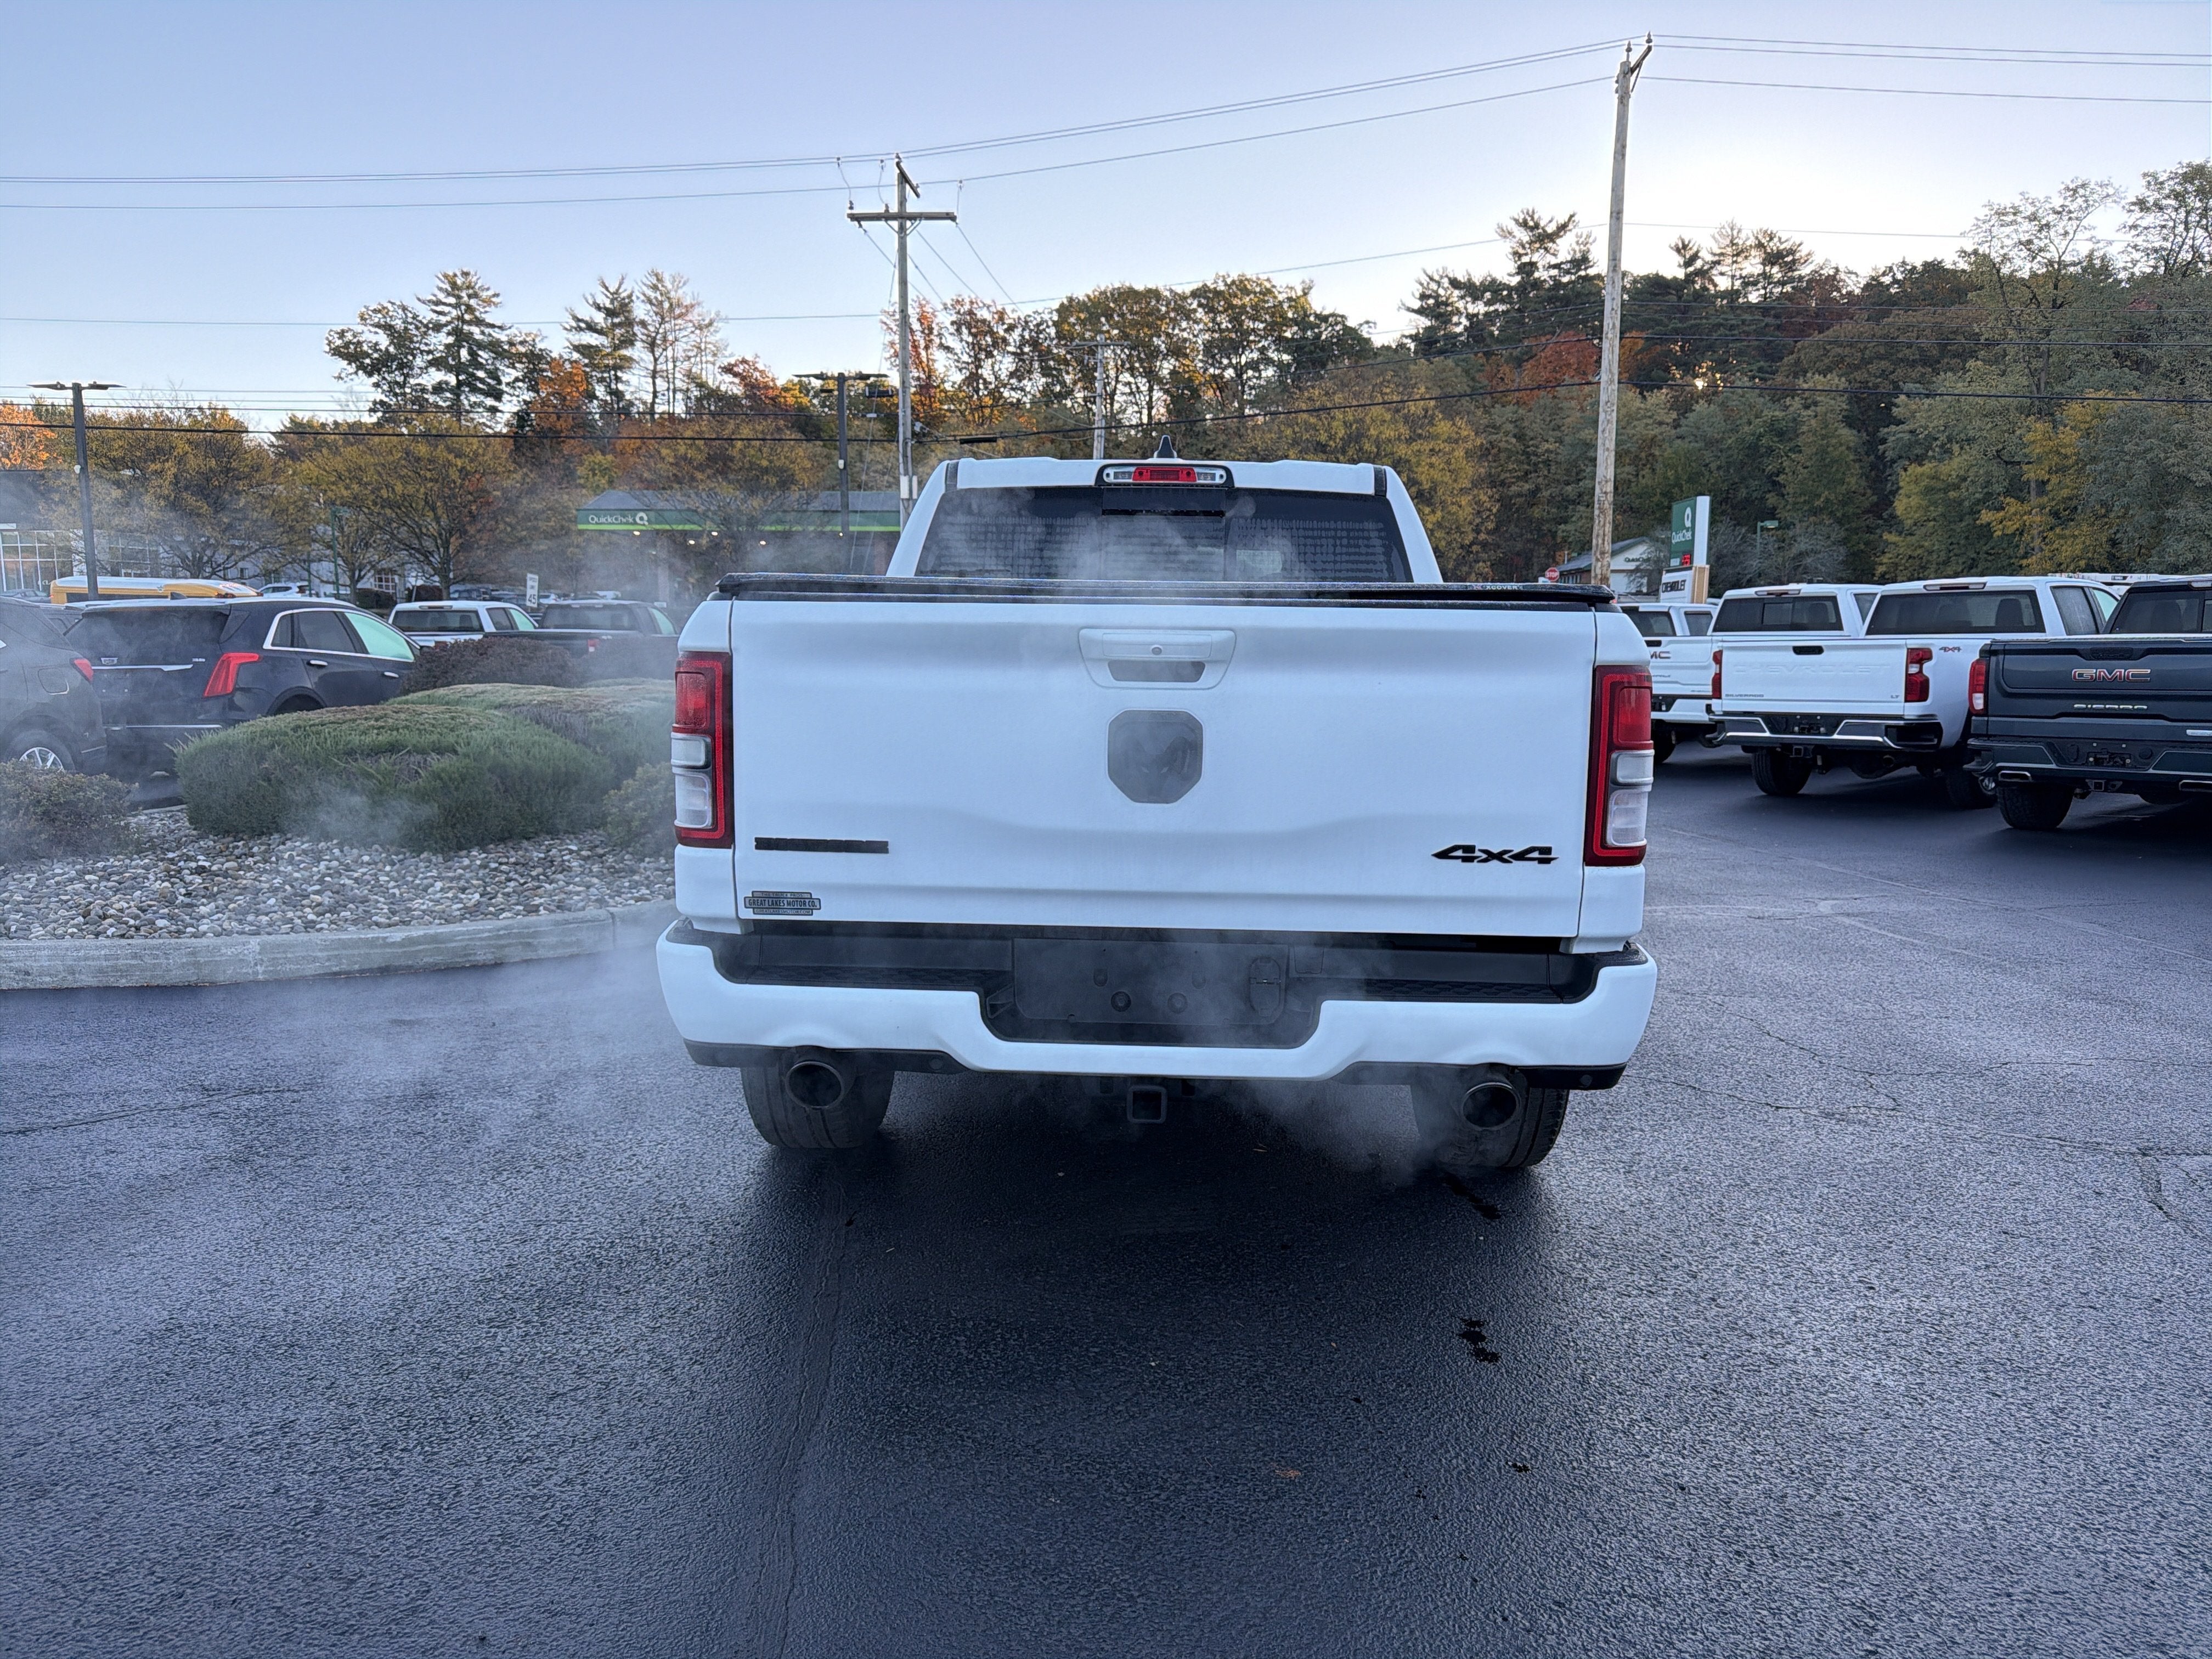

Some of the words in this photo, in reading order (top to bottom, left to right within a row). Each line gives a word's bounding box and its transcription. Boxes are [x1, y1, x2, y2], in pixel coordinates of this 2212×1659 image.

[589, 515, 634, 523] QuickChek
[1672, 529, 1692, 544] QuickChek
[528, 594, 537, 605] 45
[1650, 651, 1671, 659] MC
[2072, 669, 2151, 682] GMC
[1431, 844, 1560, 865] 4x4
[748, 898, 766, 907] GREAT
[768, 899, 786, 907] LAKES
[786, 899, 807, 907] MOTOR
[808, 900, 817, 908] CO.
